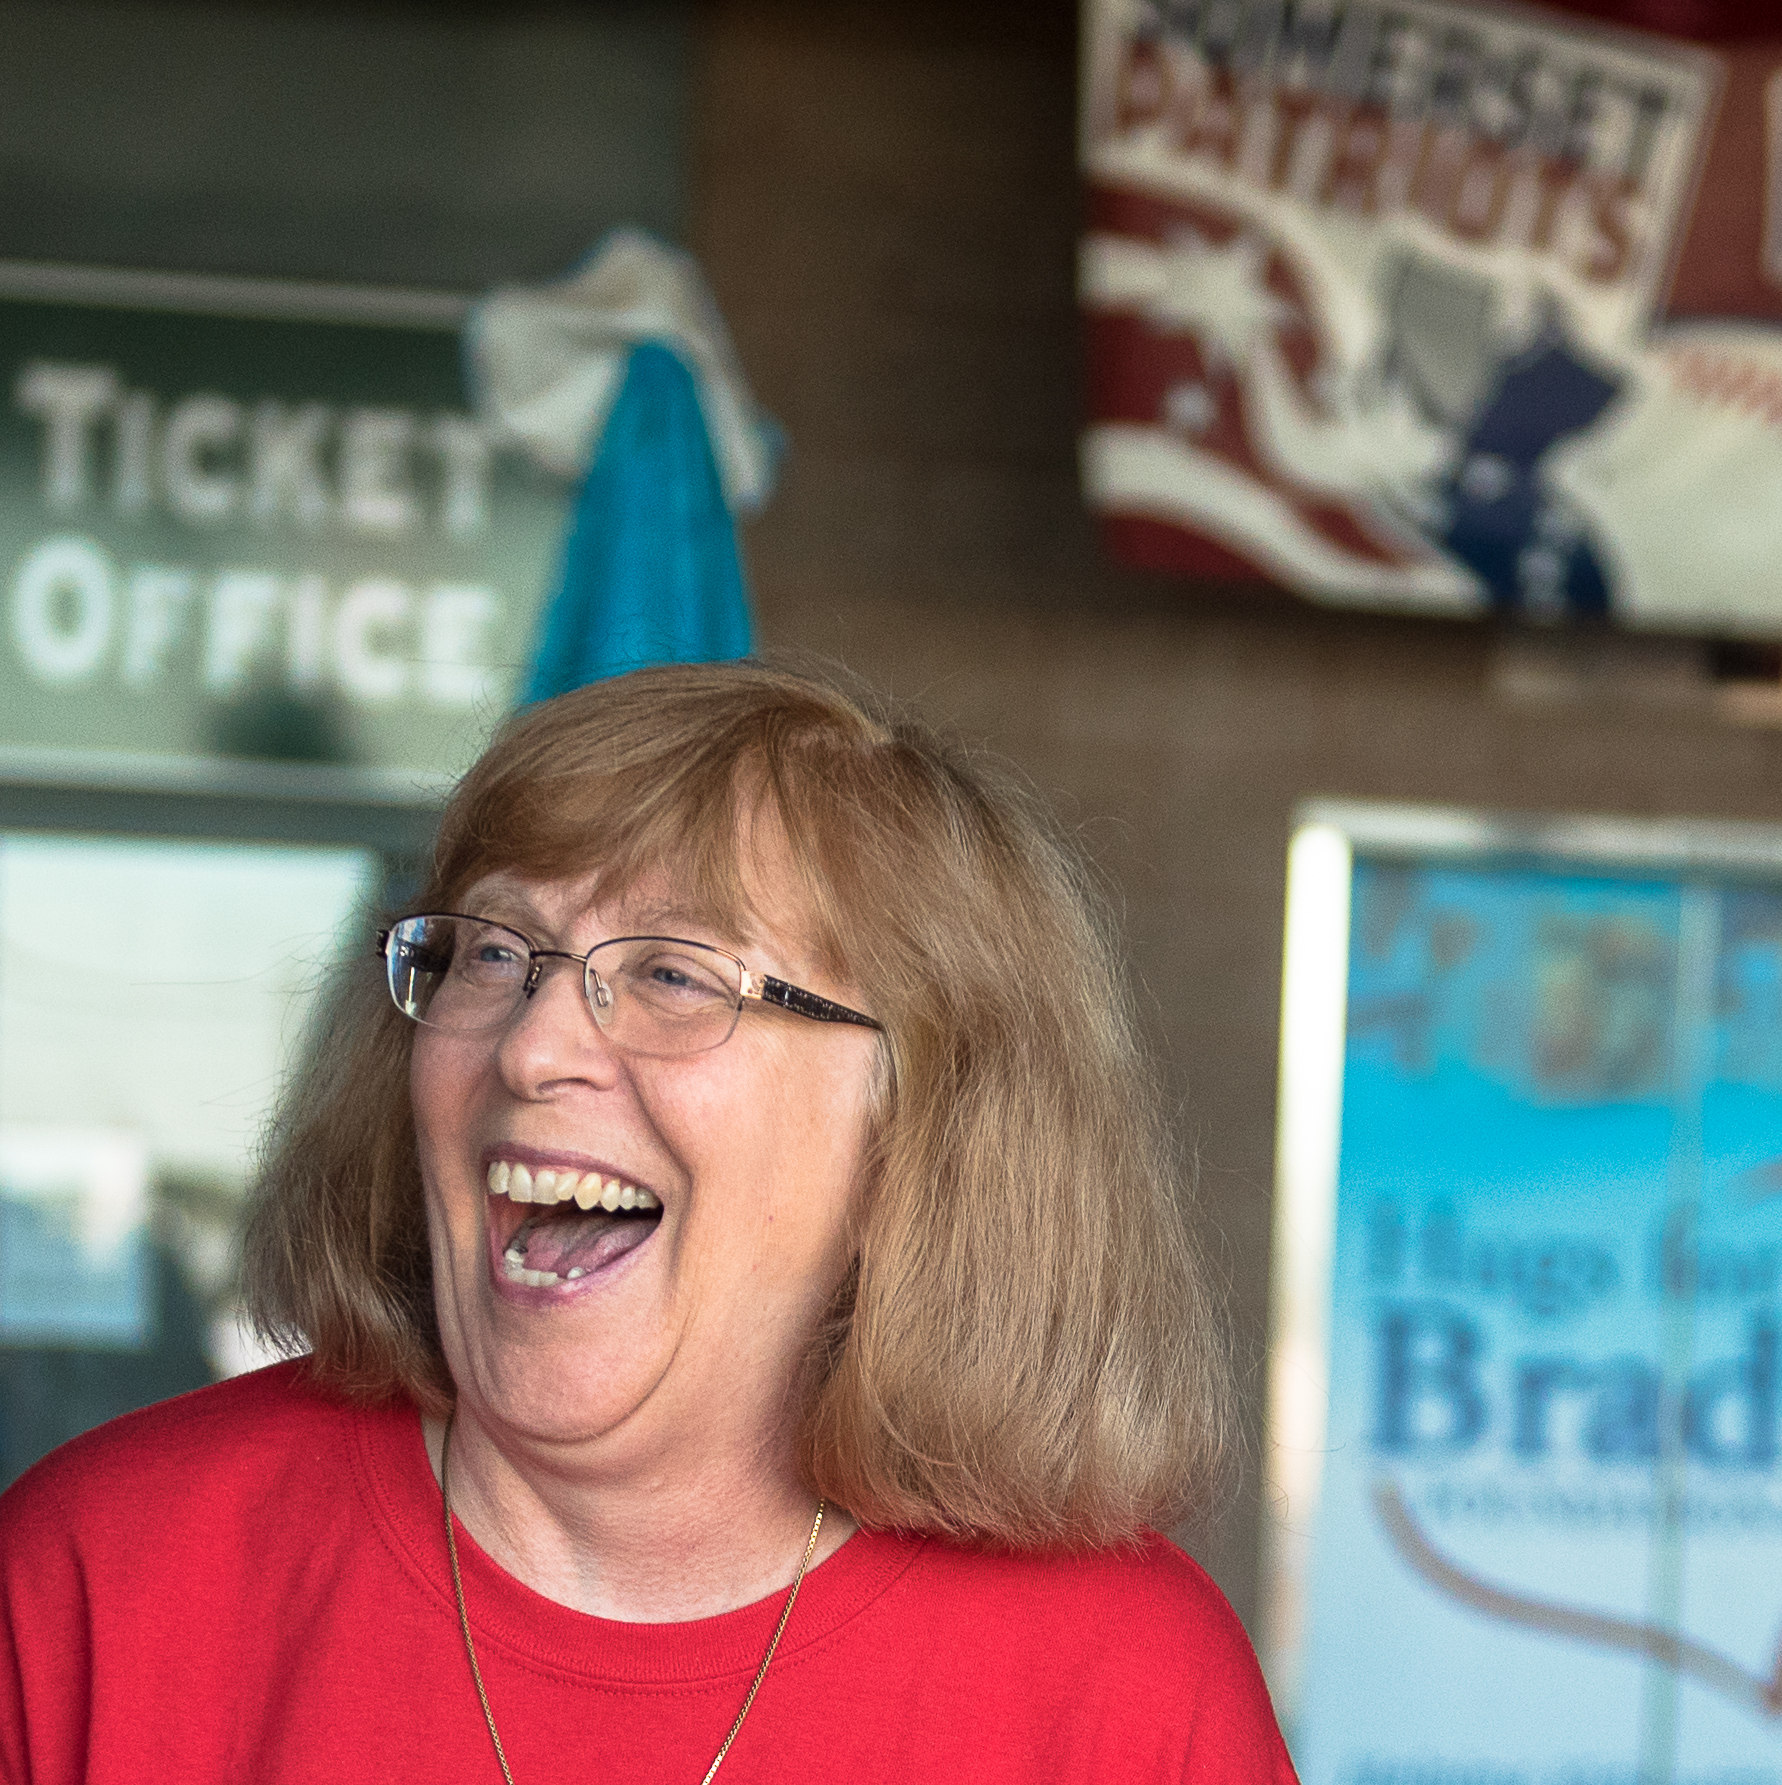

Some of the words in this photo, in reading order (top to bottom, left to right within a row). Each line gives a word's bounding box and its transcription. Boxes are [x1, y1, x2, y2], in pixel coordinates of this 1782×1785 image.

[1115, 38, 1642, 282] PATRIOTS
[20, 363, 501, 535] TICKET
[7, 530, 505, 708] OFFICE
[1363, 1190, 1621, 1320] Hugs
[1647, 1196, 1781, 1300] for
